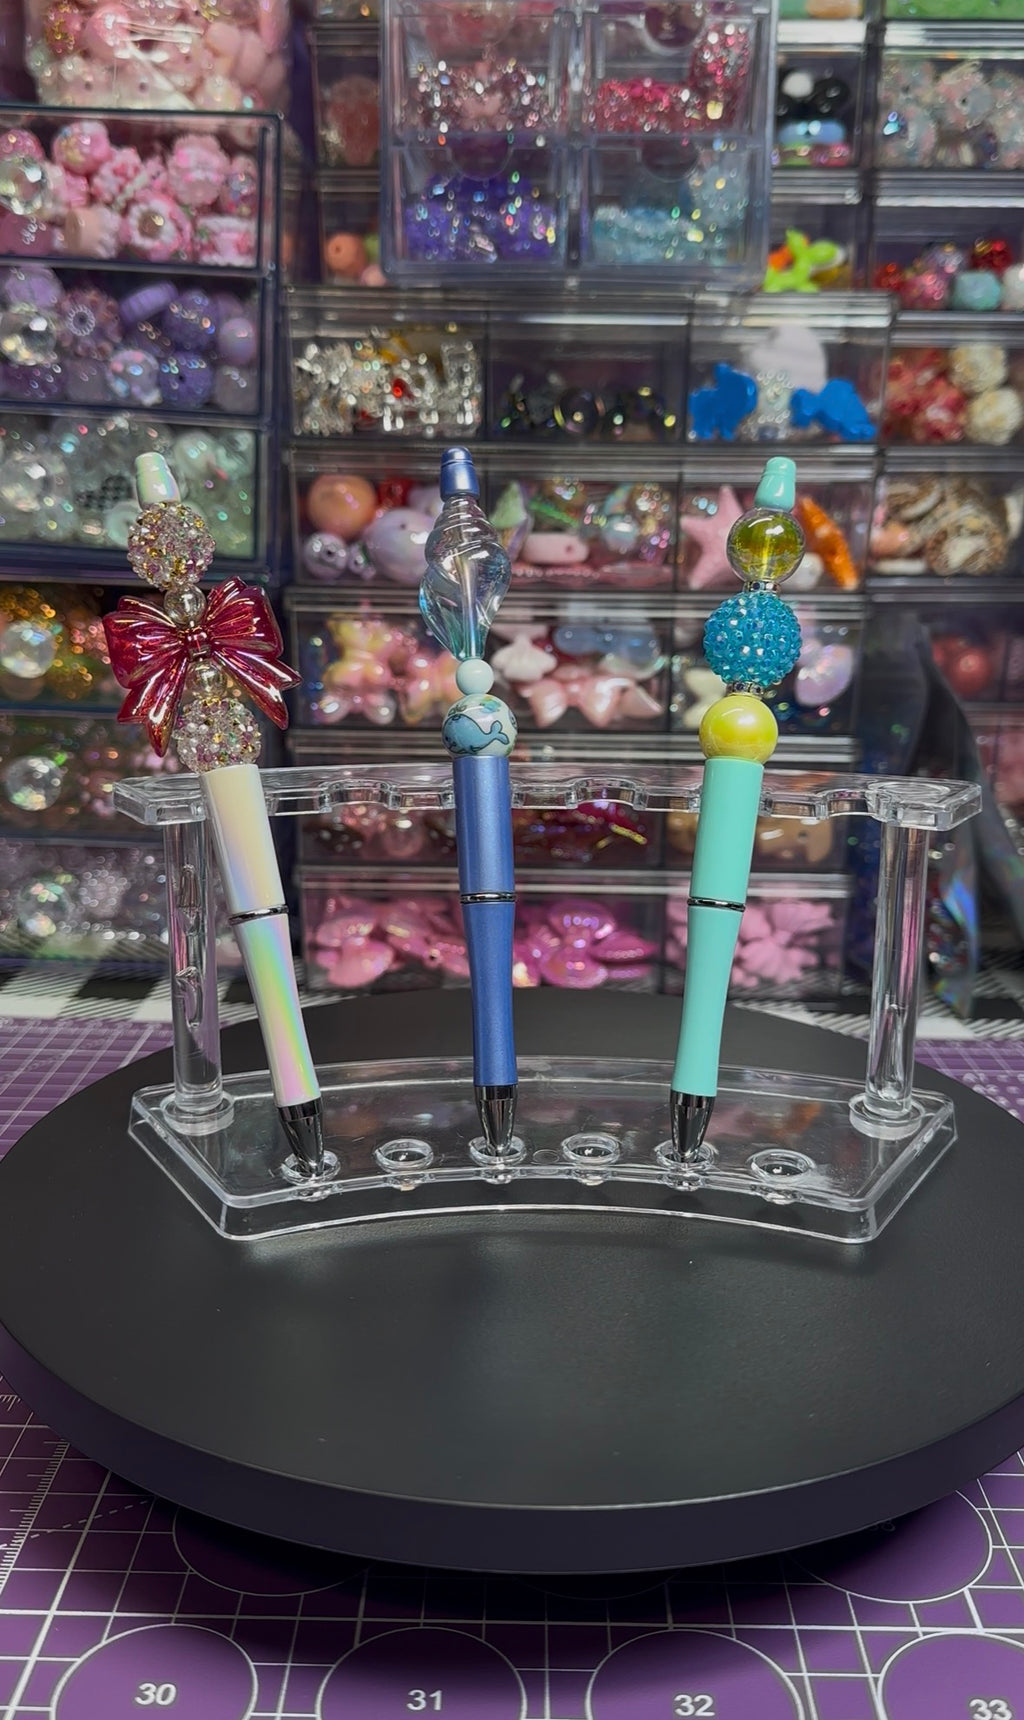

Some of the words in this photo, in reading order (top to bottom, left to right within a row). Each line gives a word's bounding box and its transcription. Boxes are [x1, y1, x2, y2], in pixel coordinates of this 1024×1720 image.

[134, 1682, 177, 1706] 30
[406, 1689, 442, 1711] 31
[673, 1694, 716, 1717] 32
[969, 1698, 1013, 1720] 33
